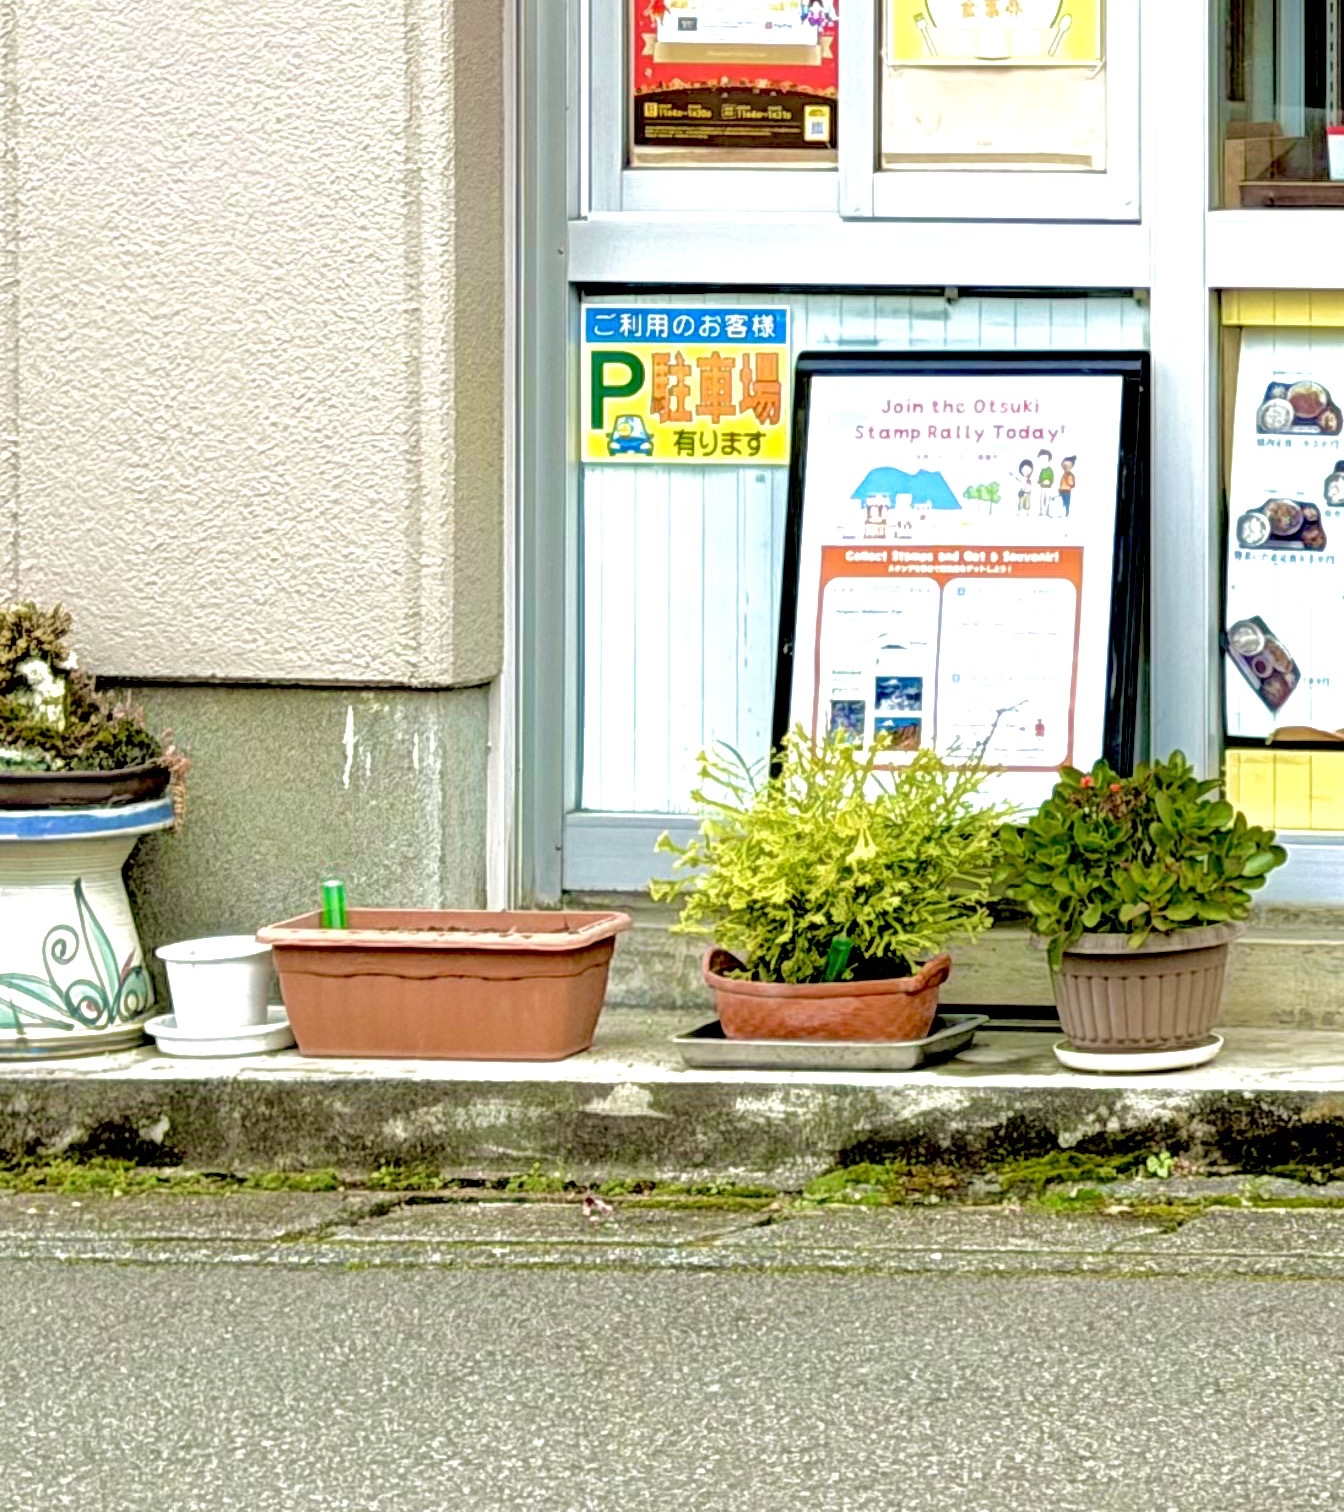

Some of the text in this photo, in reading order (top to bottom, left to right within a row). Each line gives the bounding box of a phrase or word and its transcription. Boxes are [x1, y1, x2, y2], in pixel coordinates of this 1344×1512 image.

[593, 313, 776, 339] ご利用のお客様
[591, 350, 645, 430] P
[650, 350, 782, 426] 駐車場
[881, 399, 1040, 414] Join the Otsuki
[673, 429, 767, 457] 有ります
[855, 425, 921, 443] Stamp
[928, 425, 985, 443] Rally
